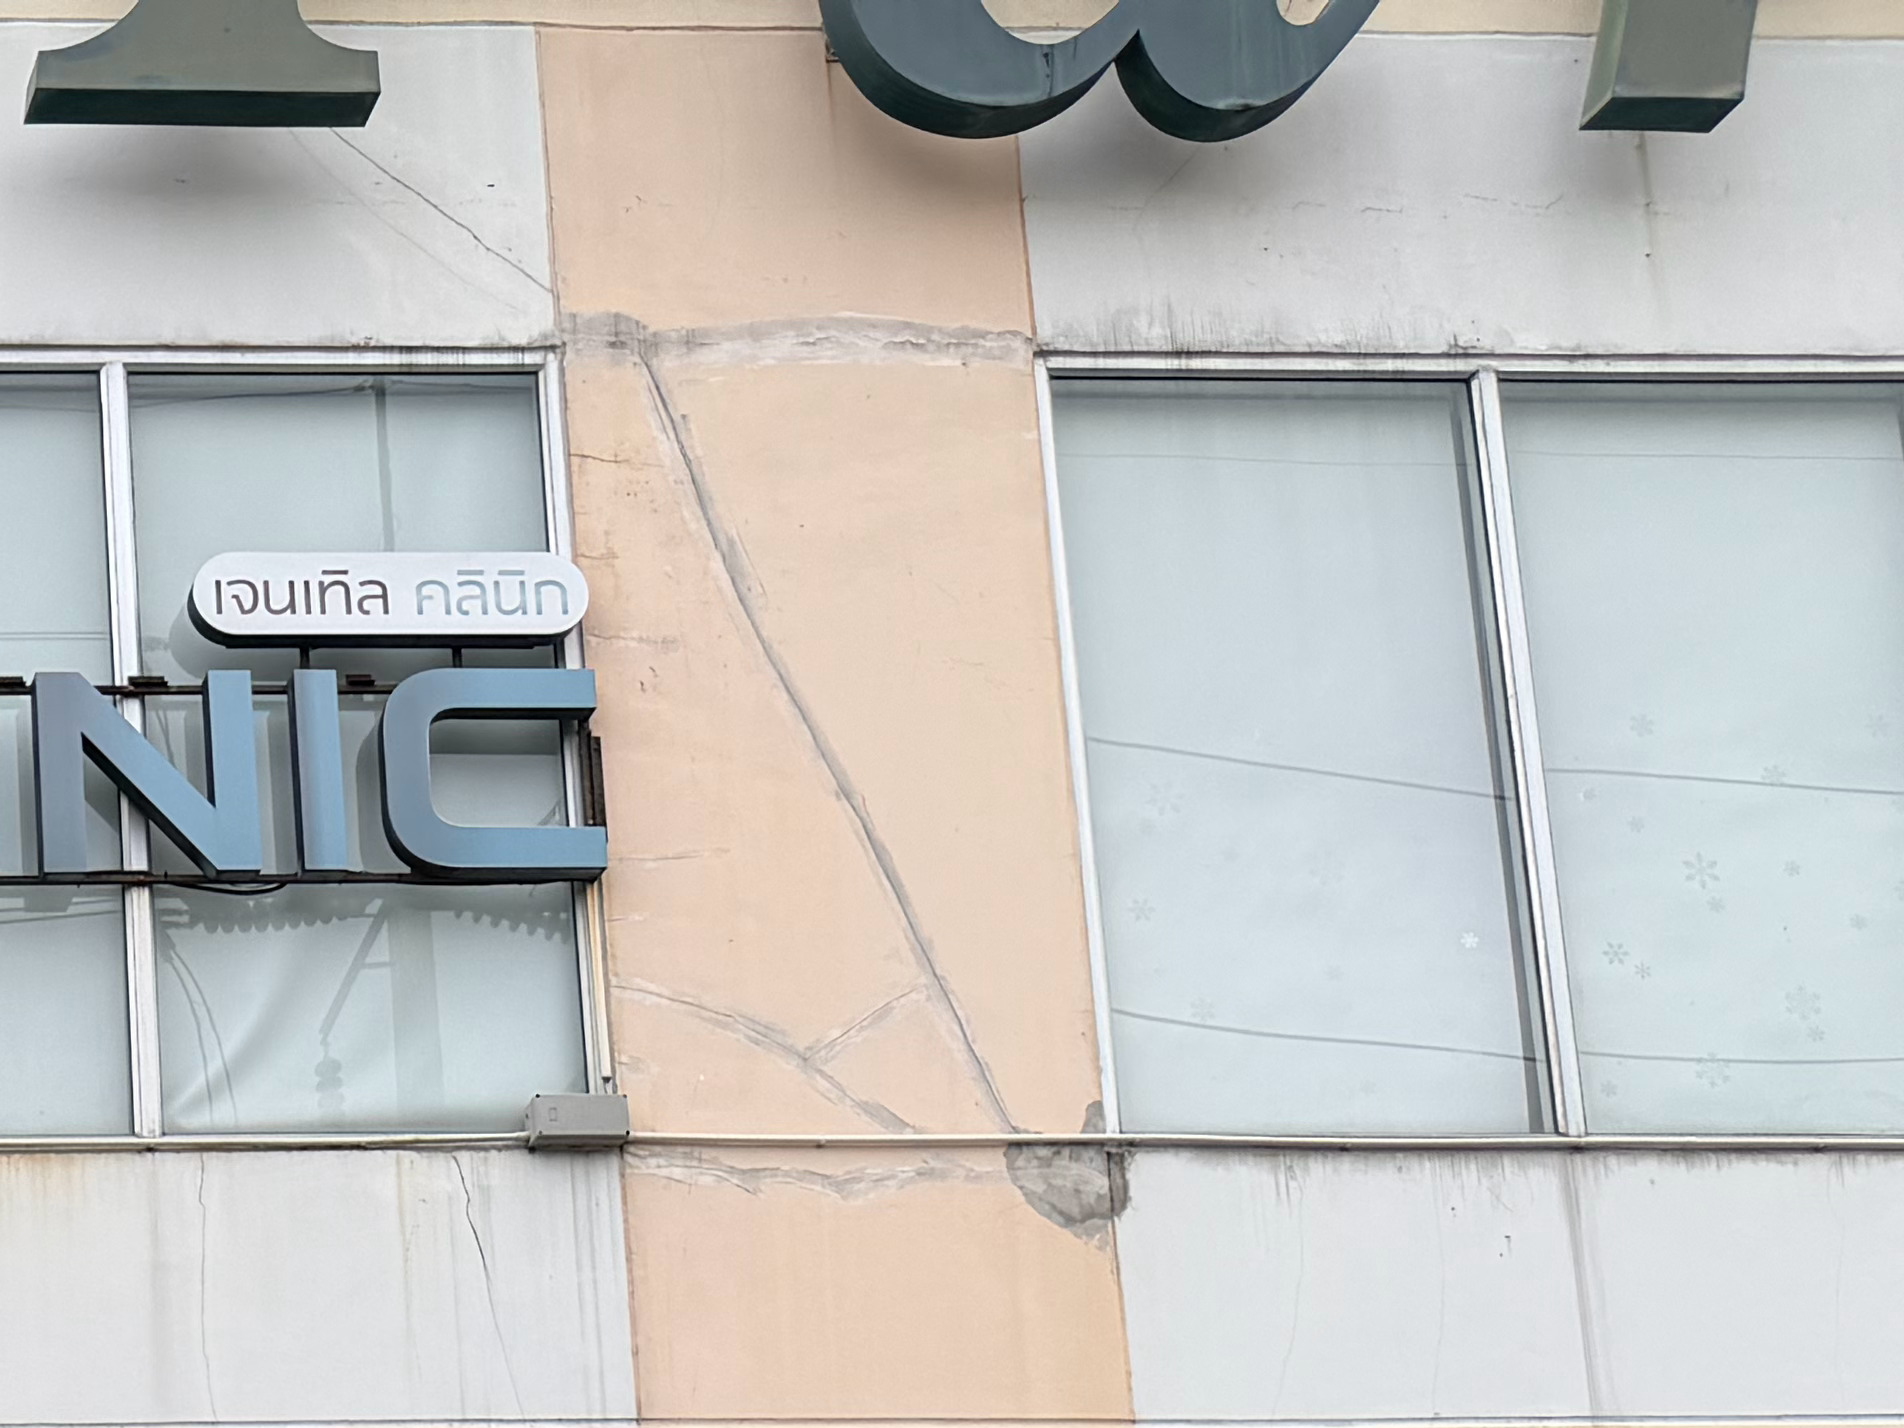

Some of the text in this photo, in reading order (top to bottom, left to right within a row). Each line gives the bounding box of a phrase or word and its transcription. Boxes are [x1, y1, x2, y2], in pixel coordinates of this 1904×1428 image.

[214, 568, 569, 616] เจนเทิล คลินิก
